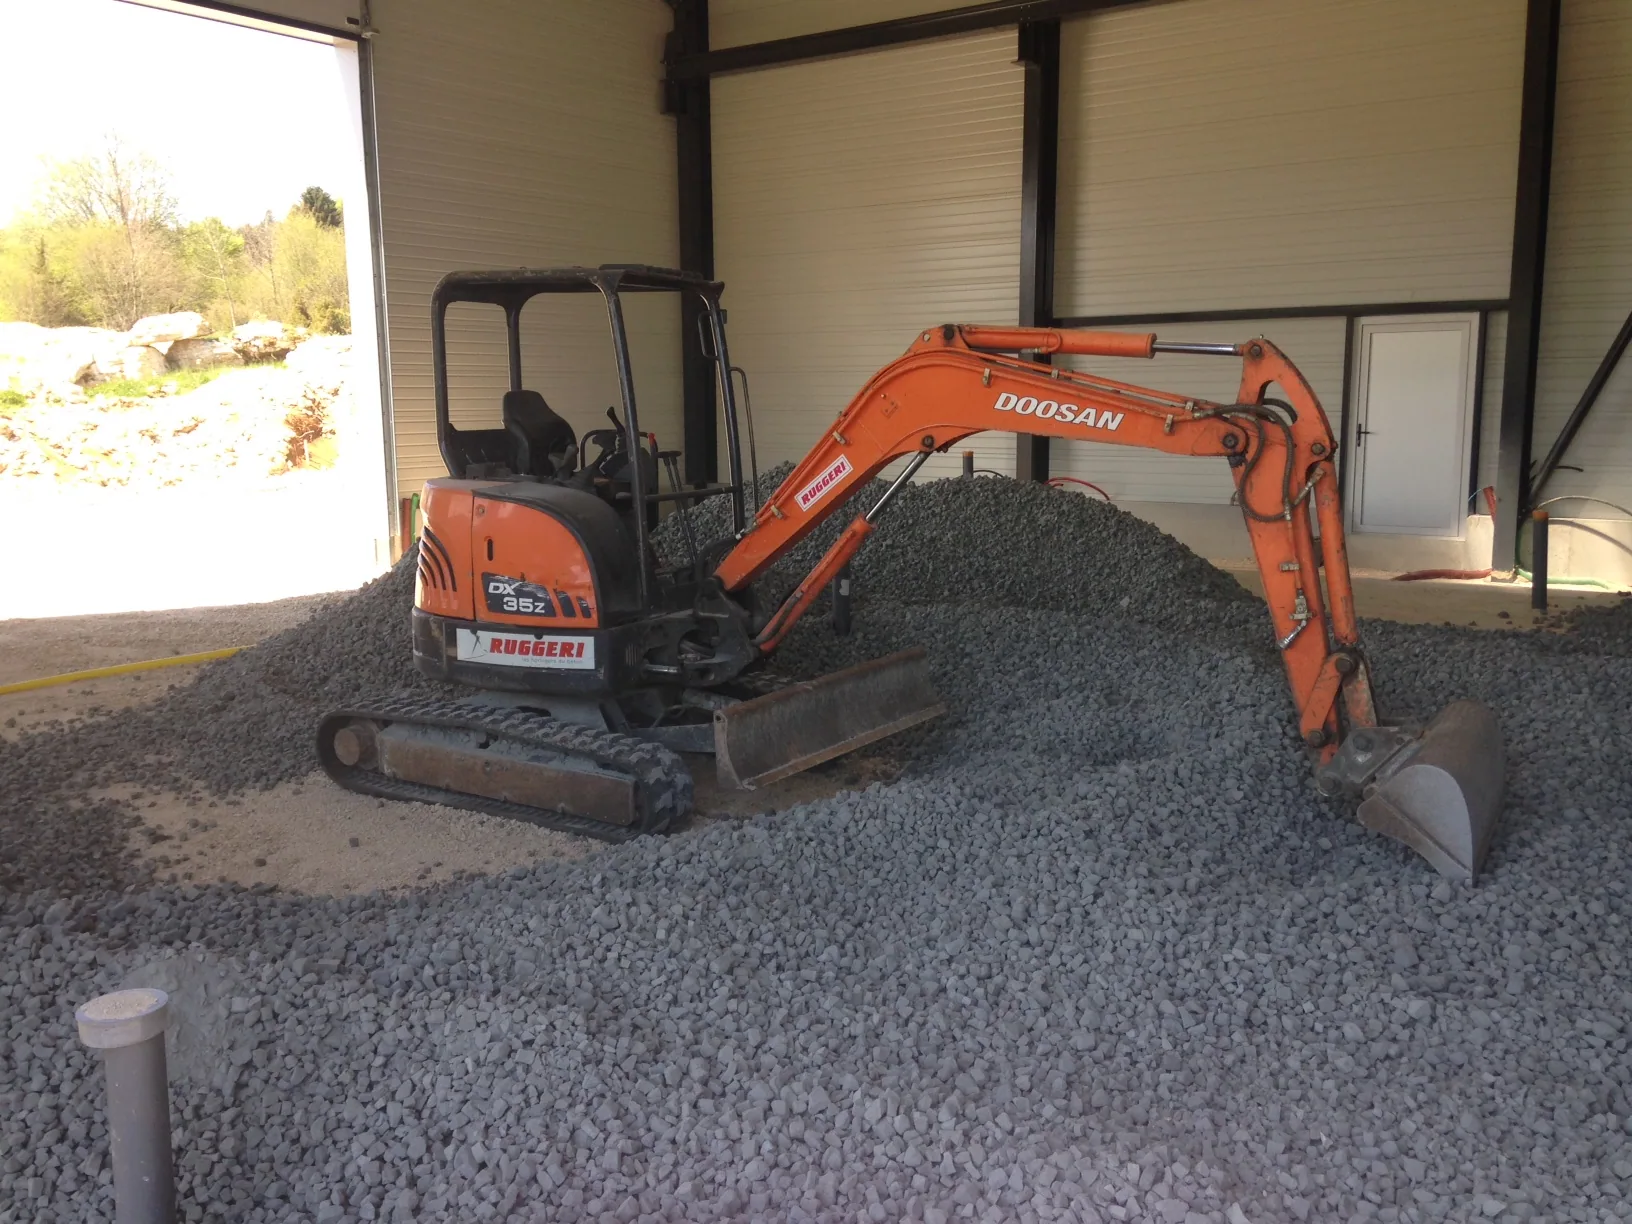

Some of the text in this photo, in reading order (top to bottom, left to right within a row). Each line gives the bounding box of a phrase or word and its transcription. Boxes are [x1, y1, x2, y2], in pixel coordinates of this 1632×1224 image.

[993, 392, 1125, 431] DOOSAN
[801, 461, 847, 506] RUGGERI
[488, 582, 522, 595] DX
[489, 638, 585, 658] RUGGERI
